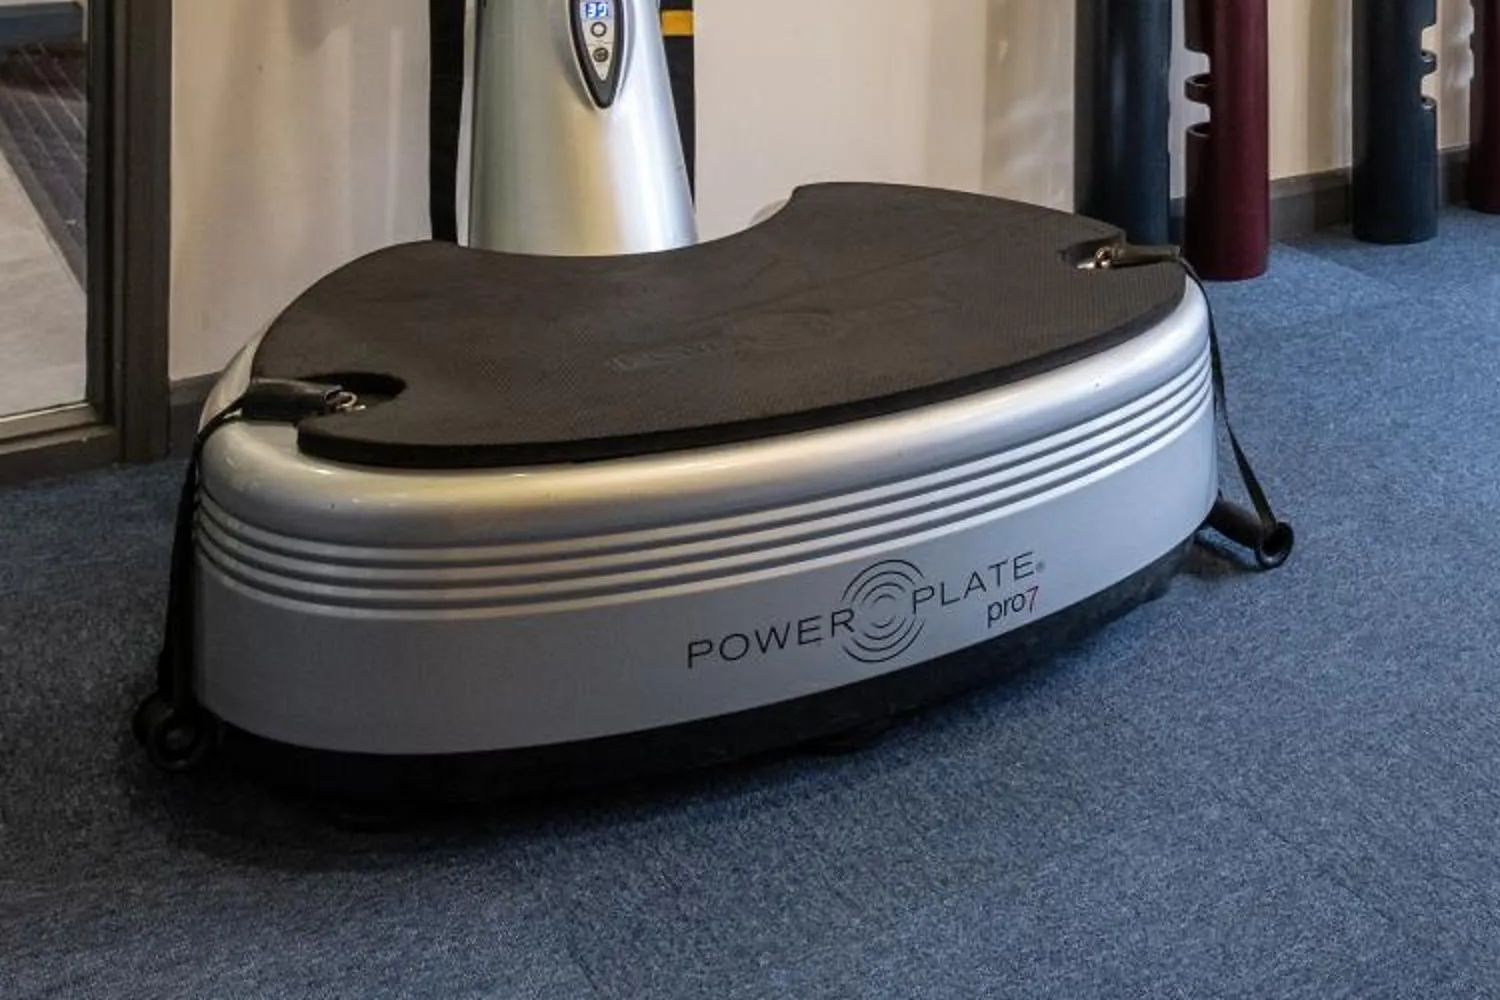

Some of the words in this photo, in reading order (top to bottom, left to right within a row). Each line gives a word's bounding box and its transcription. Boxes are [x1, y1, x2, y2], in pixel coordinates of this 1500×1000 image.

[686, 608, 856, 669] POWER
[912, 551, 1035, 614] PLATE
[986, 585, 1040, 629] pro7
